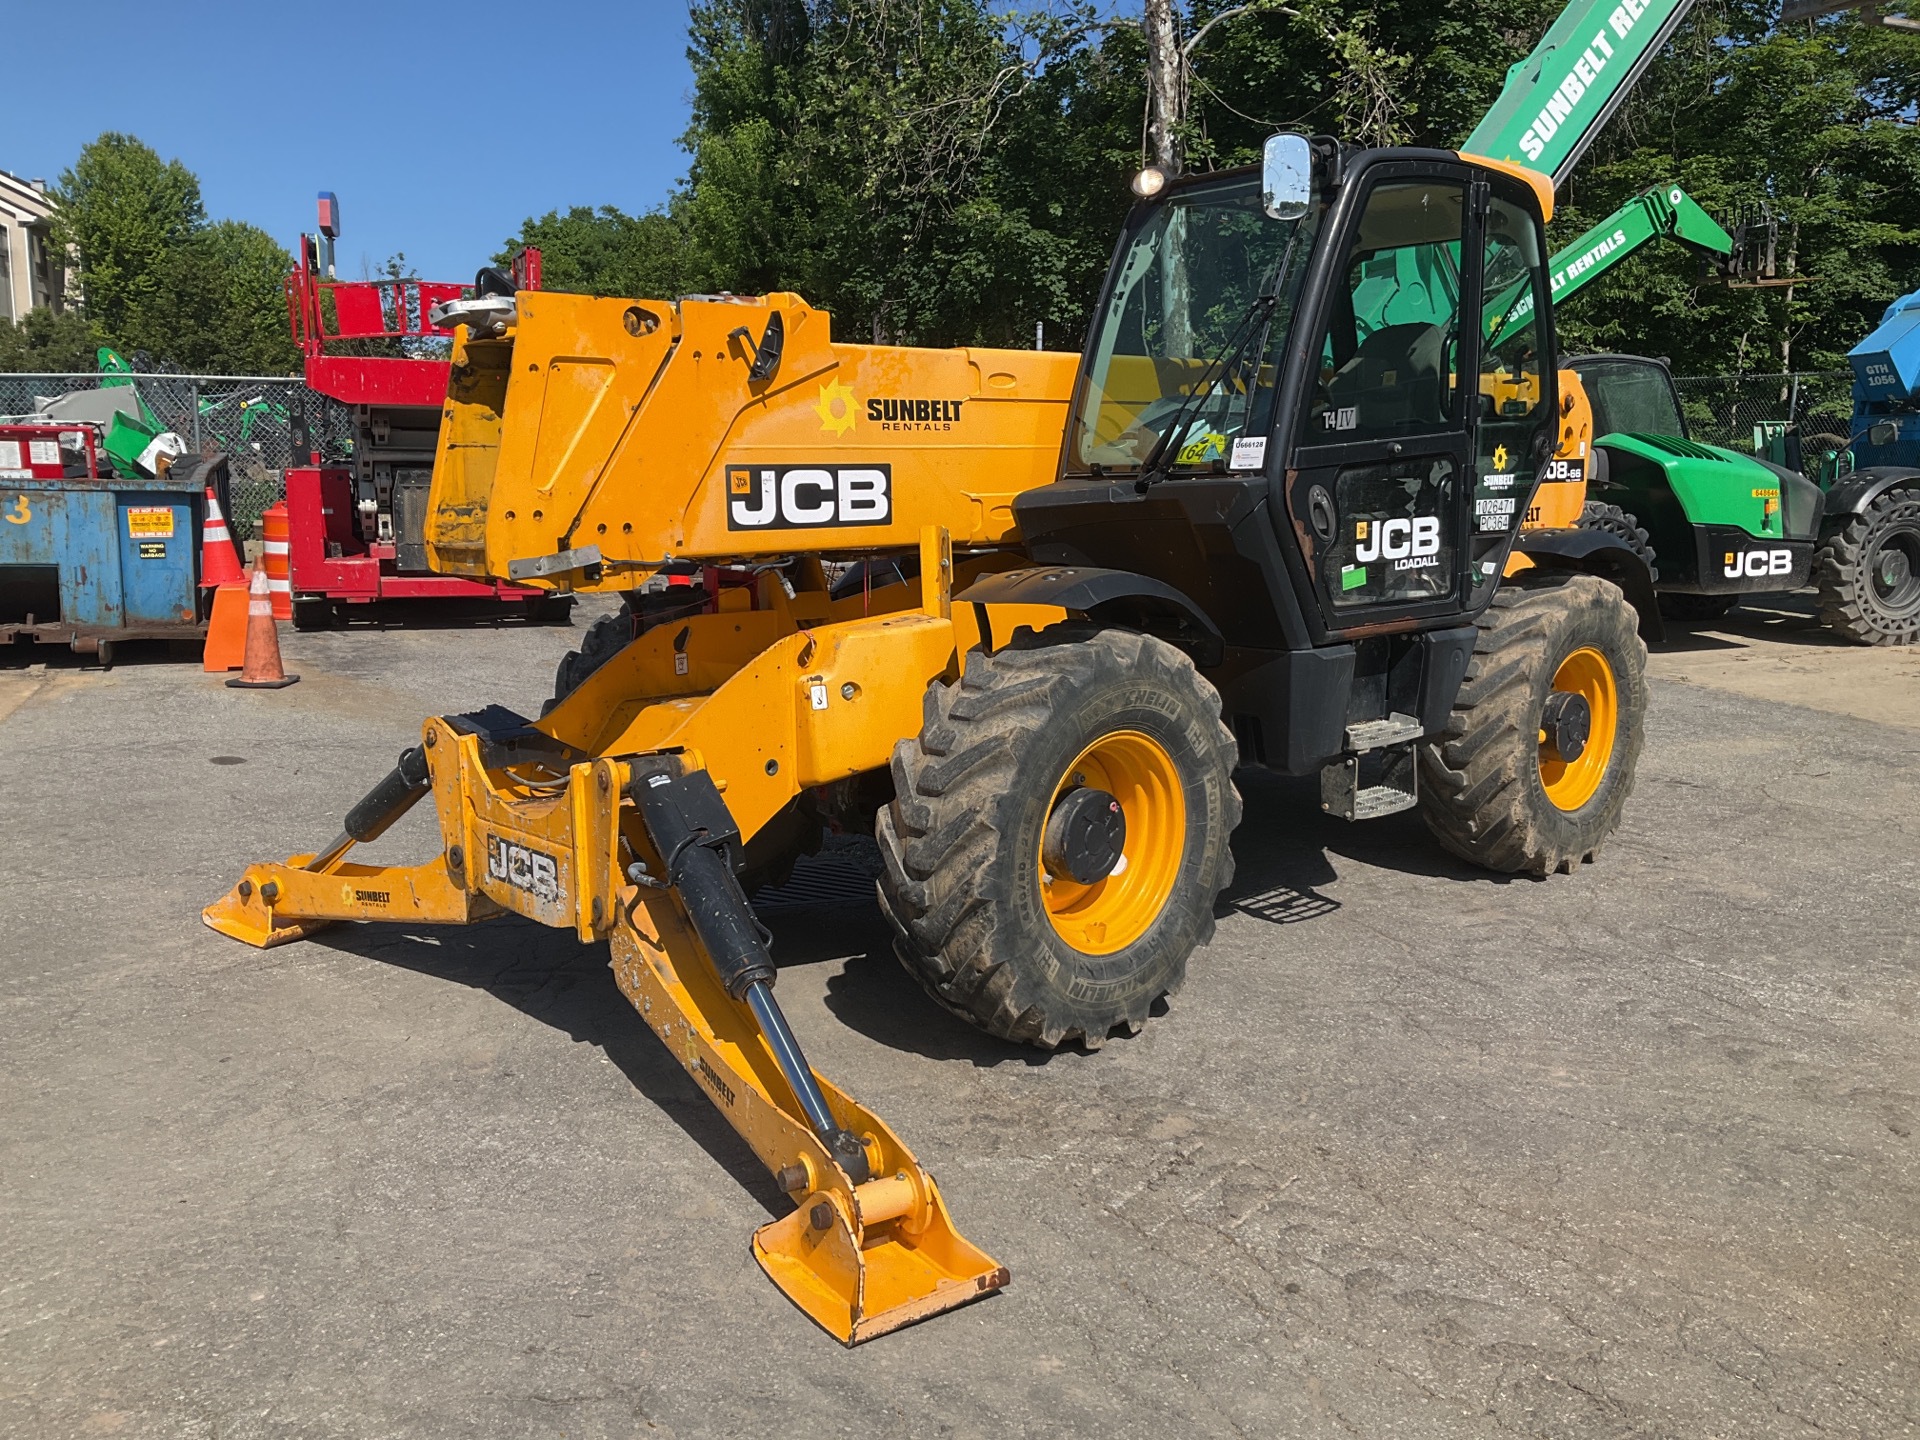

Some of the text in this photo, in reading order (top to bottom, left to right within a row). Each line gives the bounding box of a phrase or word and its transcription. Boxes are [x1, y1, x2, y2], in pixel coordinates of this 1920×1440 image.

[1519, 29, 1614, 162] SUNBELT
[1566, 229, 1626, 280] RENTALS
[1866, 364, 1889, 375] GTH
[1868, 375, 1896, 386] 1056
[867, 399, 963, 421] SUNBELT
[882, 423, 951, 431] RENTALS
[1483, 474, 1515, 486] SUNBELT
[5, 495, 31, 525] 3
[731, 469, 889, 526] JCB
[1356, 516, 1440, 562] JCB
[1395, 555, 1439, 571] LOADALL
[1724, 549, 1792, 578] JCB
[489, 842, 558, 901] JCB
[355, 890, 390, 903] SUNBELT
[700, 1055, 735, 1106] SUNBELT
